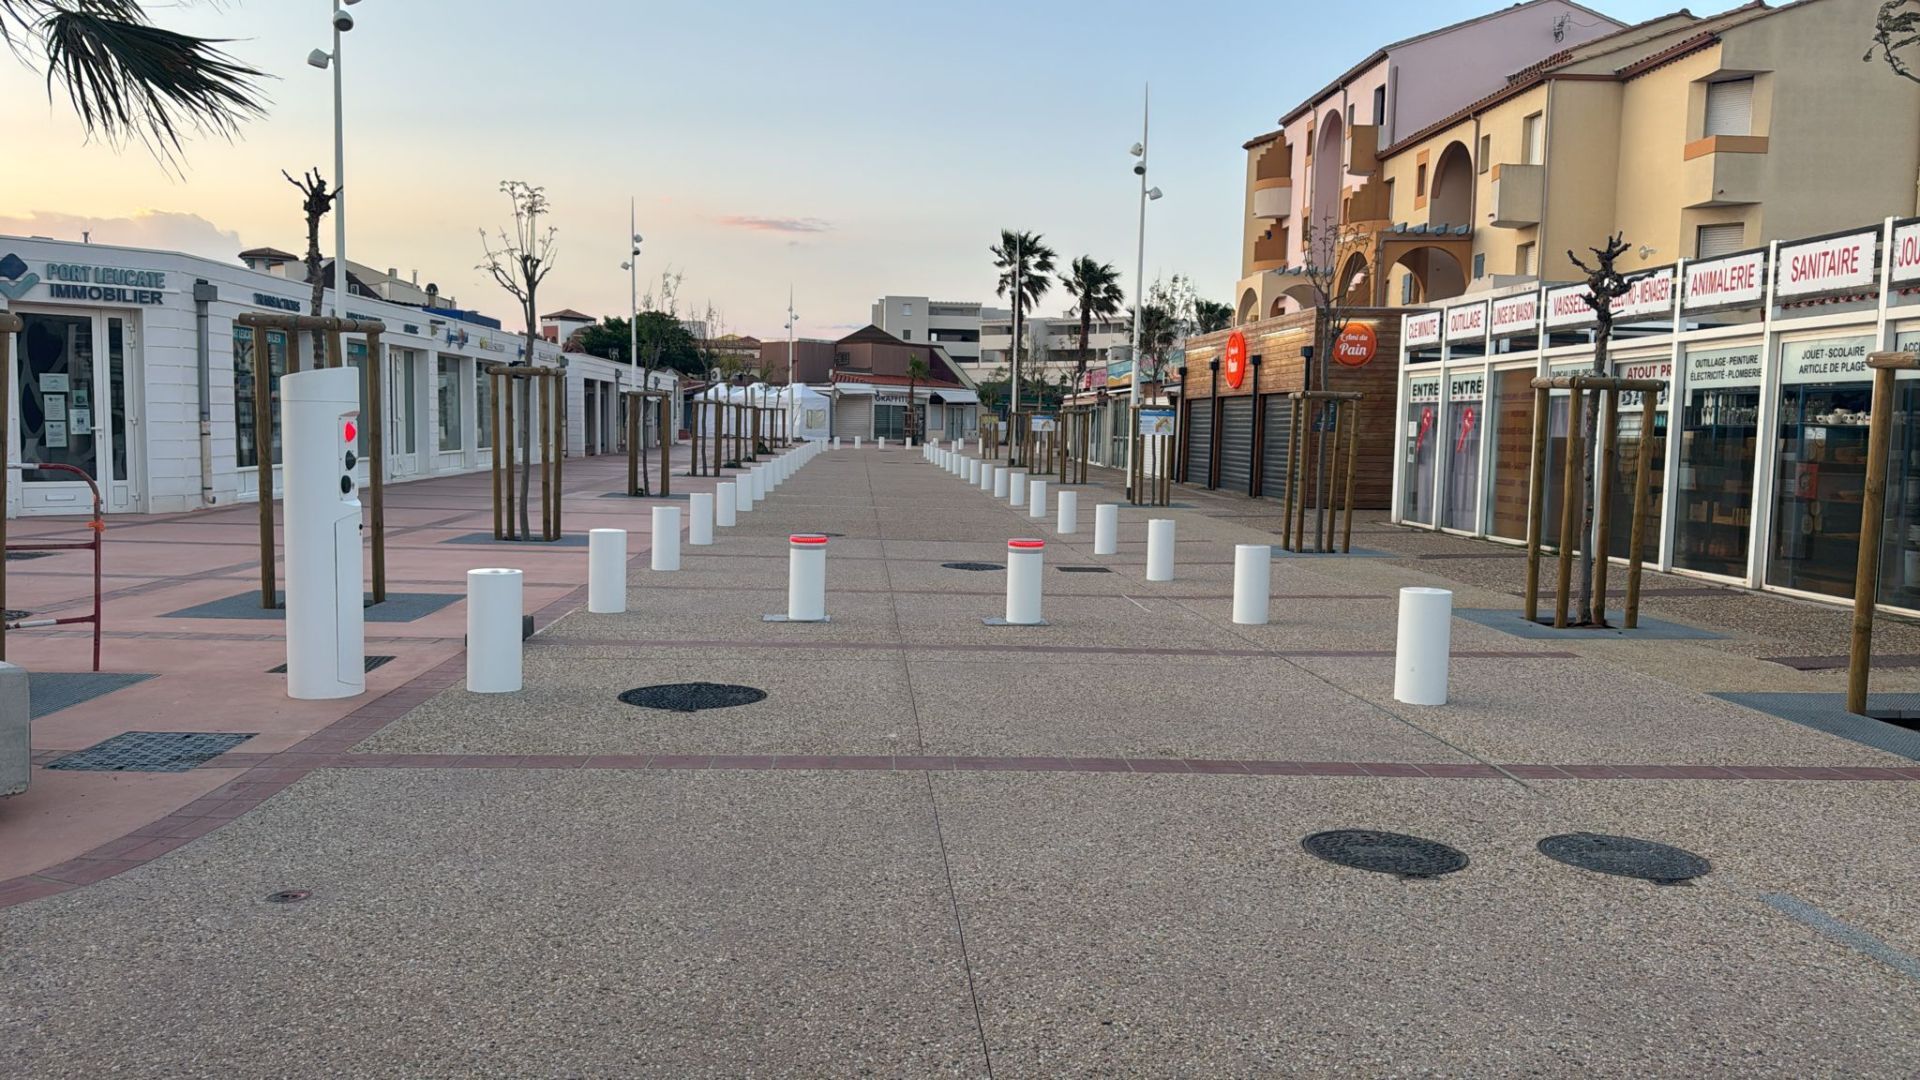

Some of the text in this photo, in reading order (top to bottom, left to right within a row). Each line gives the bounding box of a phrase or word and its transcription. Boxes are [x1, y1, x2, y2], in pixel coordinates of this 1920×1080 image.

[1791, 245, 1860, 283] SANITAIRE
[46, 262, 166, 289] PORT LEUCATE
[1690, 263, 1755, 297] ANIMALERIE
[49, 283, 164, 305] IMMOBILIER
[1450, 310, 1481, 332] OUTILLAGE
[1515, 301, 1536, 322] MAISON
[1418, 318, 1437, 337] MINUTE
[1339, 342, 1367, 356] Pain
[1627, 364, 1671, 380] ATOUT PR
[1799, 360, 1867, 375] ARTICLE DE PLAGE
[1451, 376, 1484, 395] ENTRÉ
